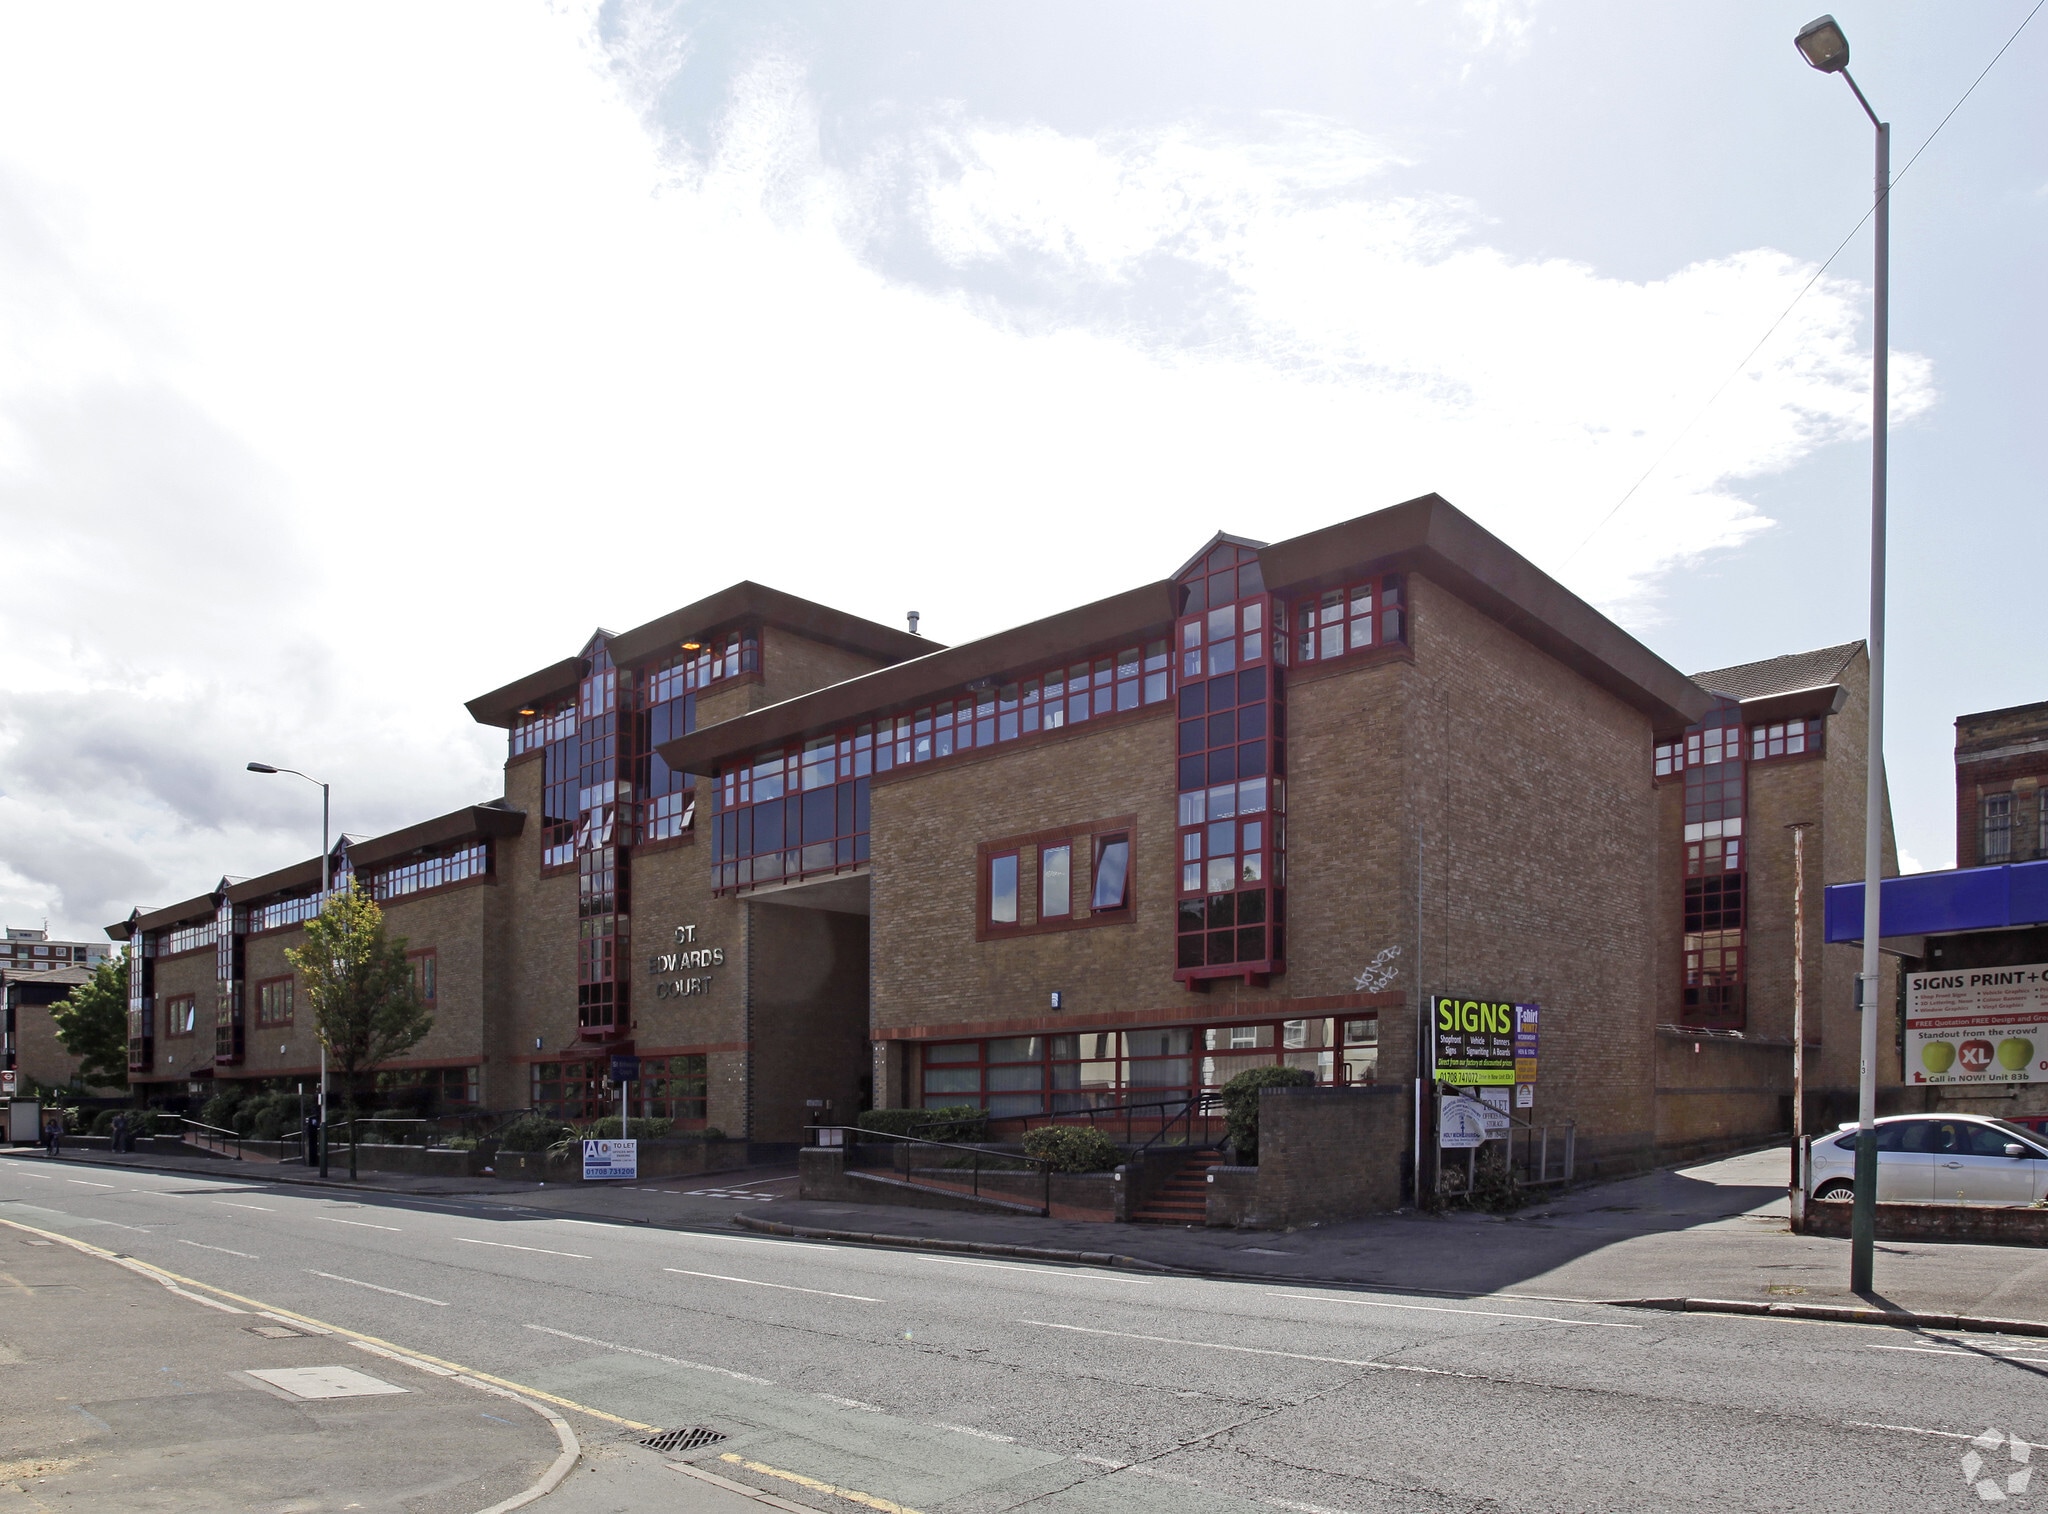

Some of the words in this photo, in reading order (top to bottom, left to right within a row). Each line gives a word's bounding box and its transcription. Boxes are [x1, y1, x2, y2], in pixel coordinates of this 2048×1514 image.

[648, 947, 725, 975] EDWARDS
[1913, 975, 1964, 991] SIGNS
[1970, 971, 2026, 987] PRINT
[656, 976, 712, 1000] COURT
[1439, 998, 1511, 1035] SIGNS
[1935, 1019, 1970, 1027] Quotation
[1971, 1017, 1990, 1025] FREE
[1991, 1016, 2016, 1024] Design
[2017, 1015, 2032, 1023] and
[1918, 1029, 1960, 1039] Standout
[1962, 1028, 1986, 1038] from
[1988, 1028, 2004, 1036] the
[2006, 1026, 2038, 1035] crowd
[1440, 1034, 1462, 1044] Shopfront
[1470, 1036, 1485, 1044] Vehicle
[1493, 1037, 1510, 1046] Banners
[1445, 1046, 1457, 1056] Signs
[1466, 1046, 1489, 1057] Signwriting
[1492, 1048, 1497, 1056] A
[1496, 1048, 1511, 1056] Boards
[1962, 1047, 1991, 1065] XL
[1449, 1058, 1459, 1067] from
[1465, 1058, 1478, 1067] factory
[1483, 1058, 1502, 1066] discounted
[1458, 1072, 1478, 1083] 747072
[1928, 1075, 1945, 1083] Call
[1958, 1074, 1986, 1082] NOW!
[2010, 1073, 2029, 1081] 83b
